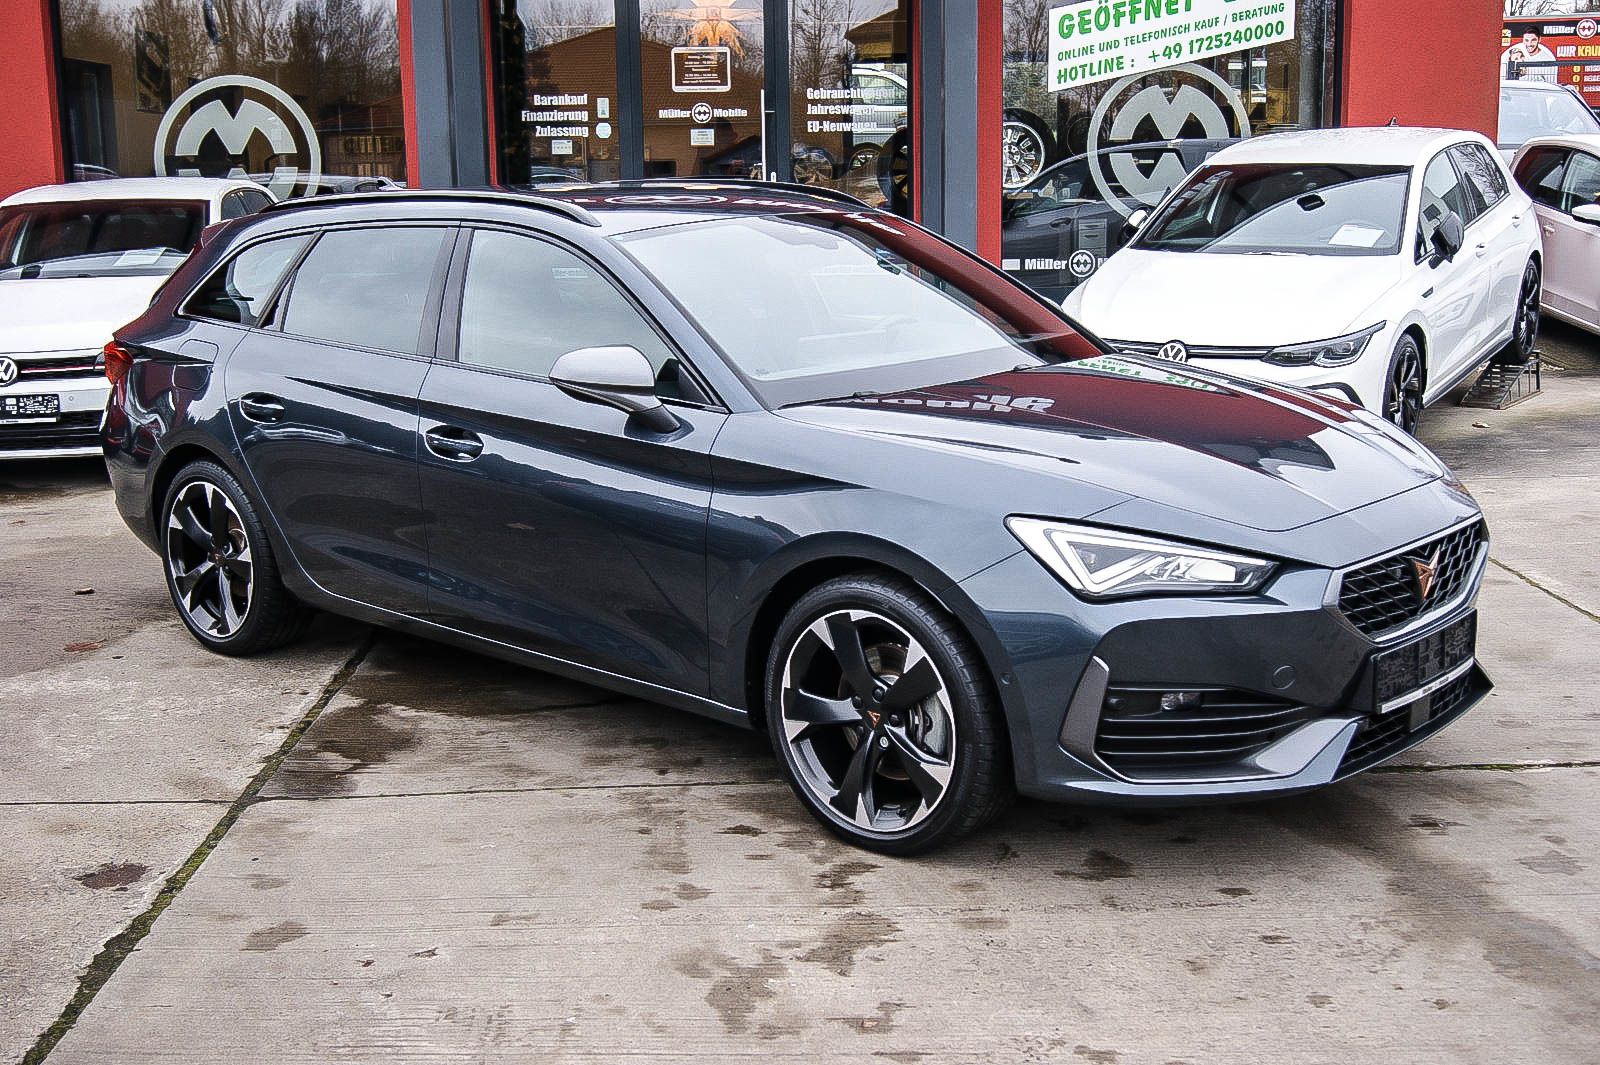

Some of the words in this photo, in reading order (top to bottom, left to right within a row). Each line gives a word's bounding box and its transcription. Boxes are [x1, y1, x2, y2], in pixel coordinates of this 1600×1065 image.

[1057, 45, 1095, 62] ONLINE
[1098, 40, 1121, 53] UND
[1123, 23, 1191, 47] TELEFONISCH
[1194, 16, 1220, 32] KAUF
[1231, 2, 1285, 23] BERATUNG
[1543, 25, 1576, 35] Müller
[1148, 43, 1183, 62] +49
[1188, 20, 1285, 55] 1725240000
[1556, 45, 1577, 58] WIR
[533, 93, 588, 106] Barankauf
[806, 87, 896, 100] Gebrauchtgen
[521, 110, 589, 122] Finanzierung
[658, 107, 692, 119] Müller
[713, 108, 748, 118] Mobile
[535, 125, 589, 138] Zulassung
[807, 120, 878, 133] EU-Neuwagen
[1024, 258, 1068, 270] Müller
